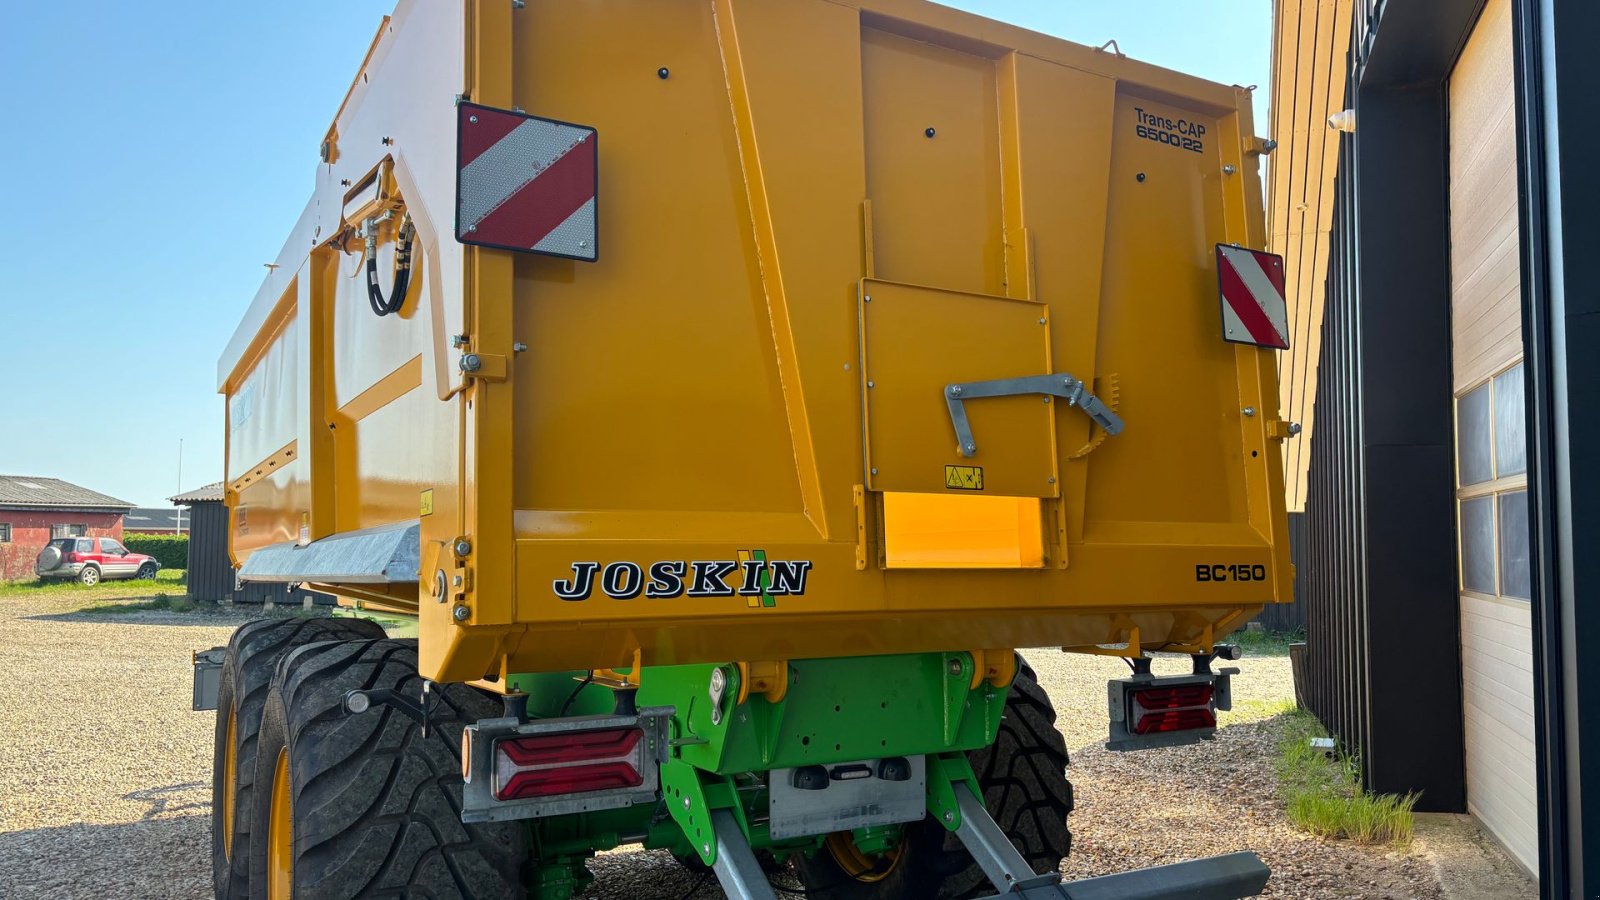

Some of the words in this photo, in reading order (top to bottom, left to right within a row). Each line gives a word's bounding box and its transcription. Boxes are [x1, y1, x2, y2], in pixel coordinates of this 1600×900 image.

[1134, 107, 1206, 138] Trans-CAP
[553, 560, 812, 601] JOSKIN
[1196, 565, 1266, 581] BC150
